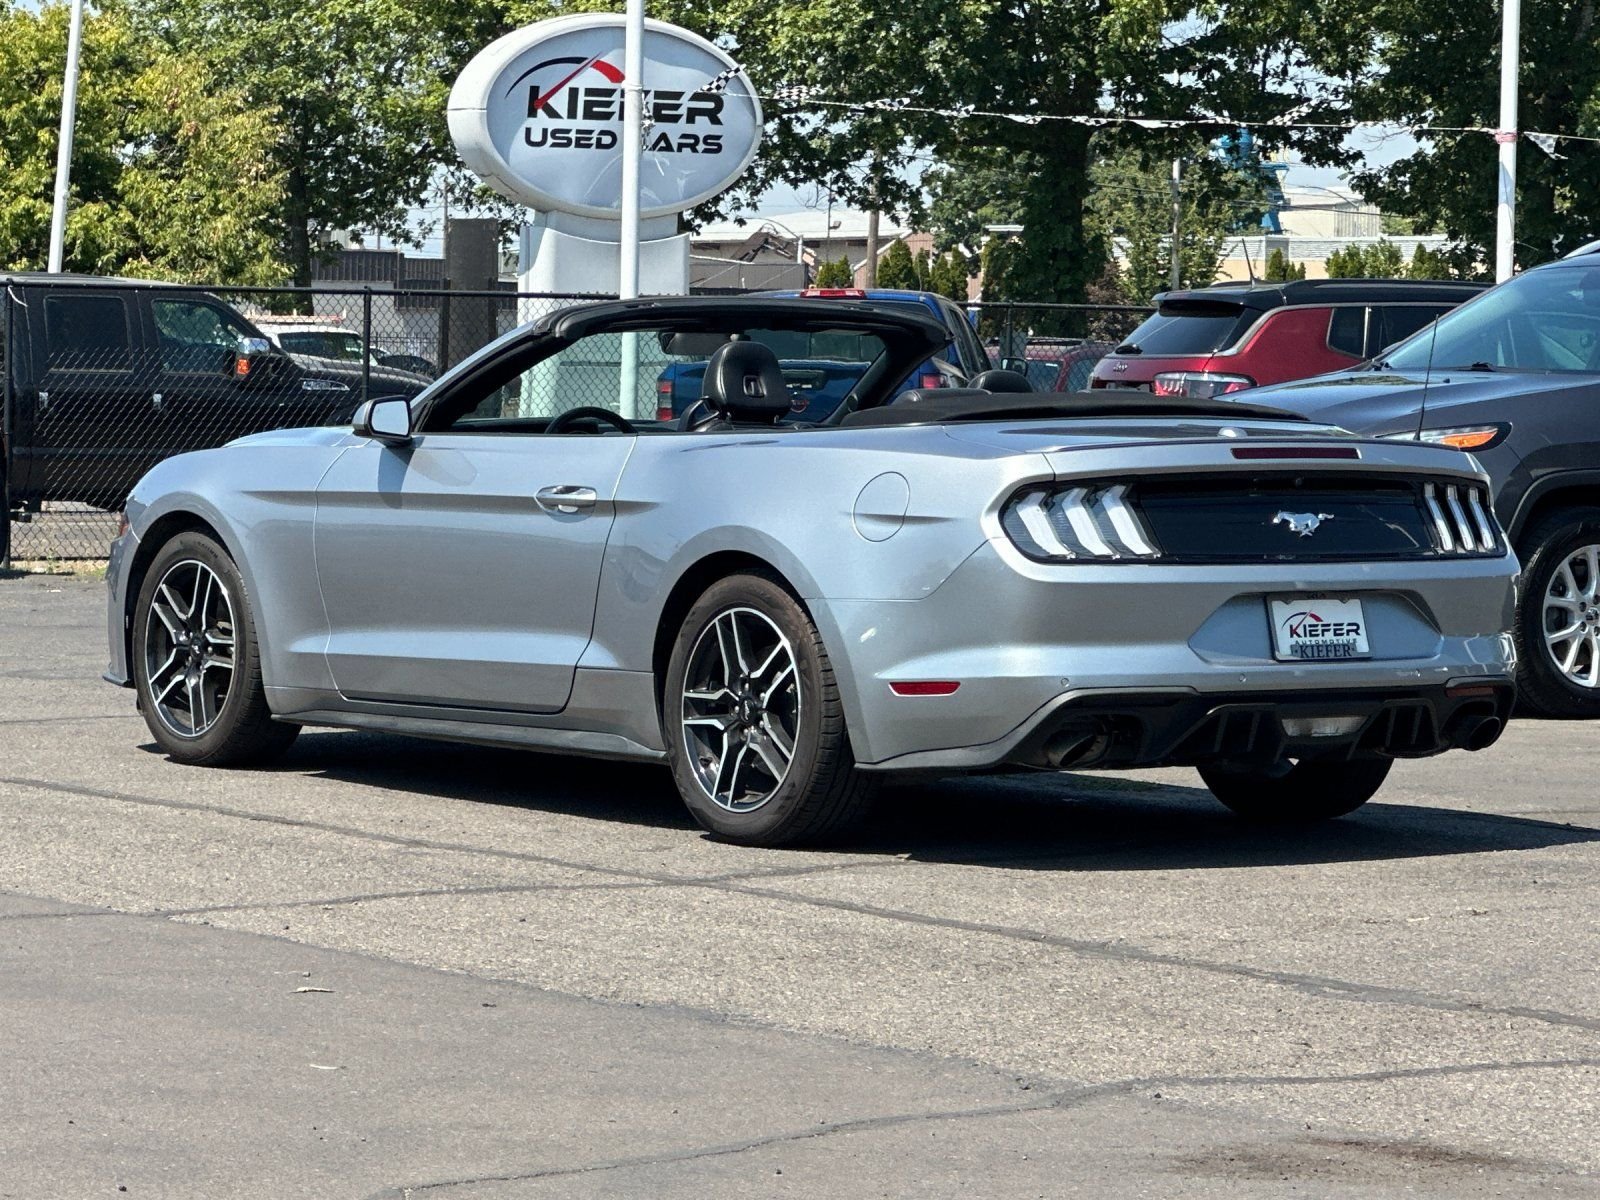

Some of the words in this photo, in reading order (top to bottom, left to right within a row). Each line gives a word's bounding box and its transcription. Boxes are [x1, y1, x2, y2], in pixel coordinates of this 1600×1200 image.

[524, 127, 618, 150] USED
[626, 131, 723, 154] ARS
[1289, 622, 1361, 638] KIEFER
[1299, 644, 1352, 658] KIEFER
